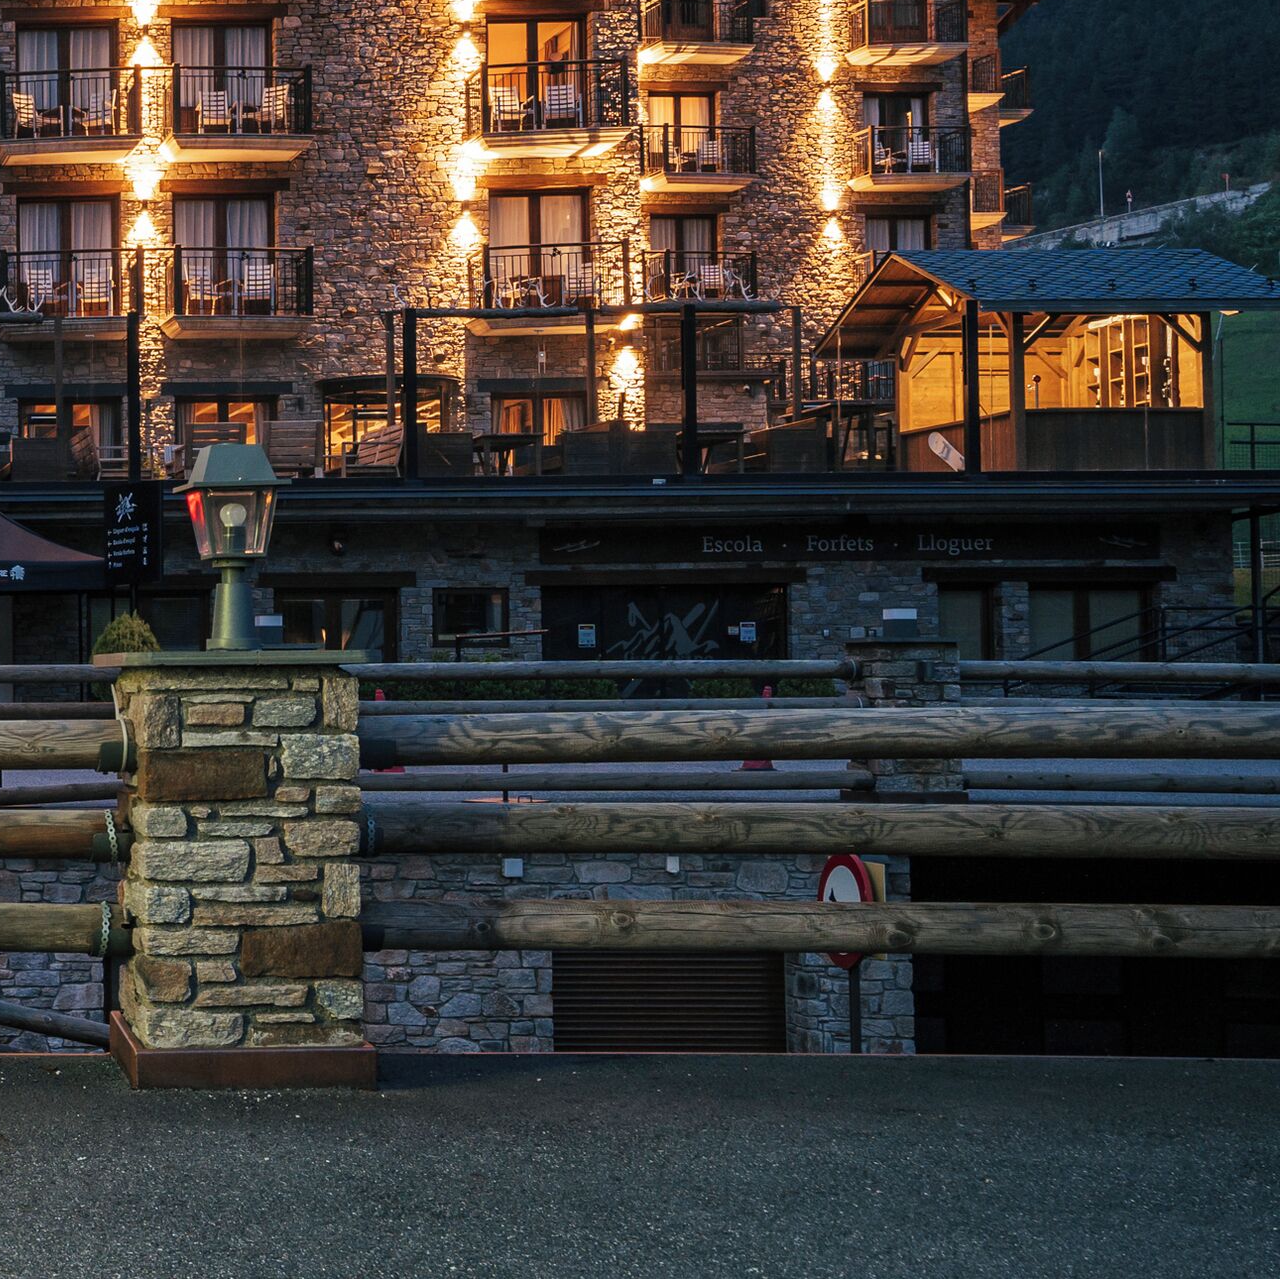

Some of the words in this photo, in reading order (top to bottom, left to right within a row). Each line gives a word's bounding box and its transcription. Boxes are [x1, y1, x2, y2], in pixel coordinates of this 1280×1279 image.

[702, 535, 763, 553] Escola
[806, 534, 874, 552] Forfets
[917, 534, 994, 556] Lloguer
